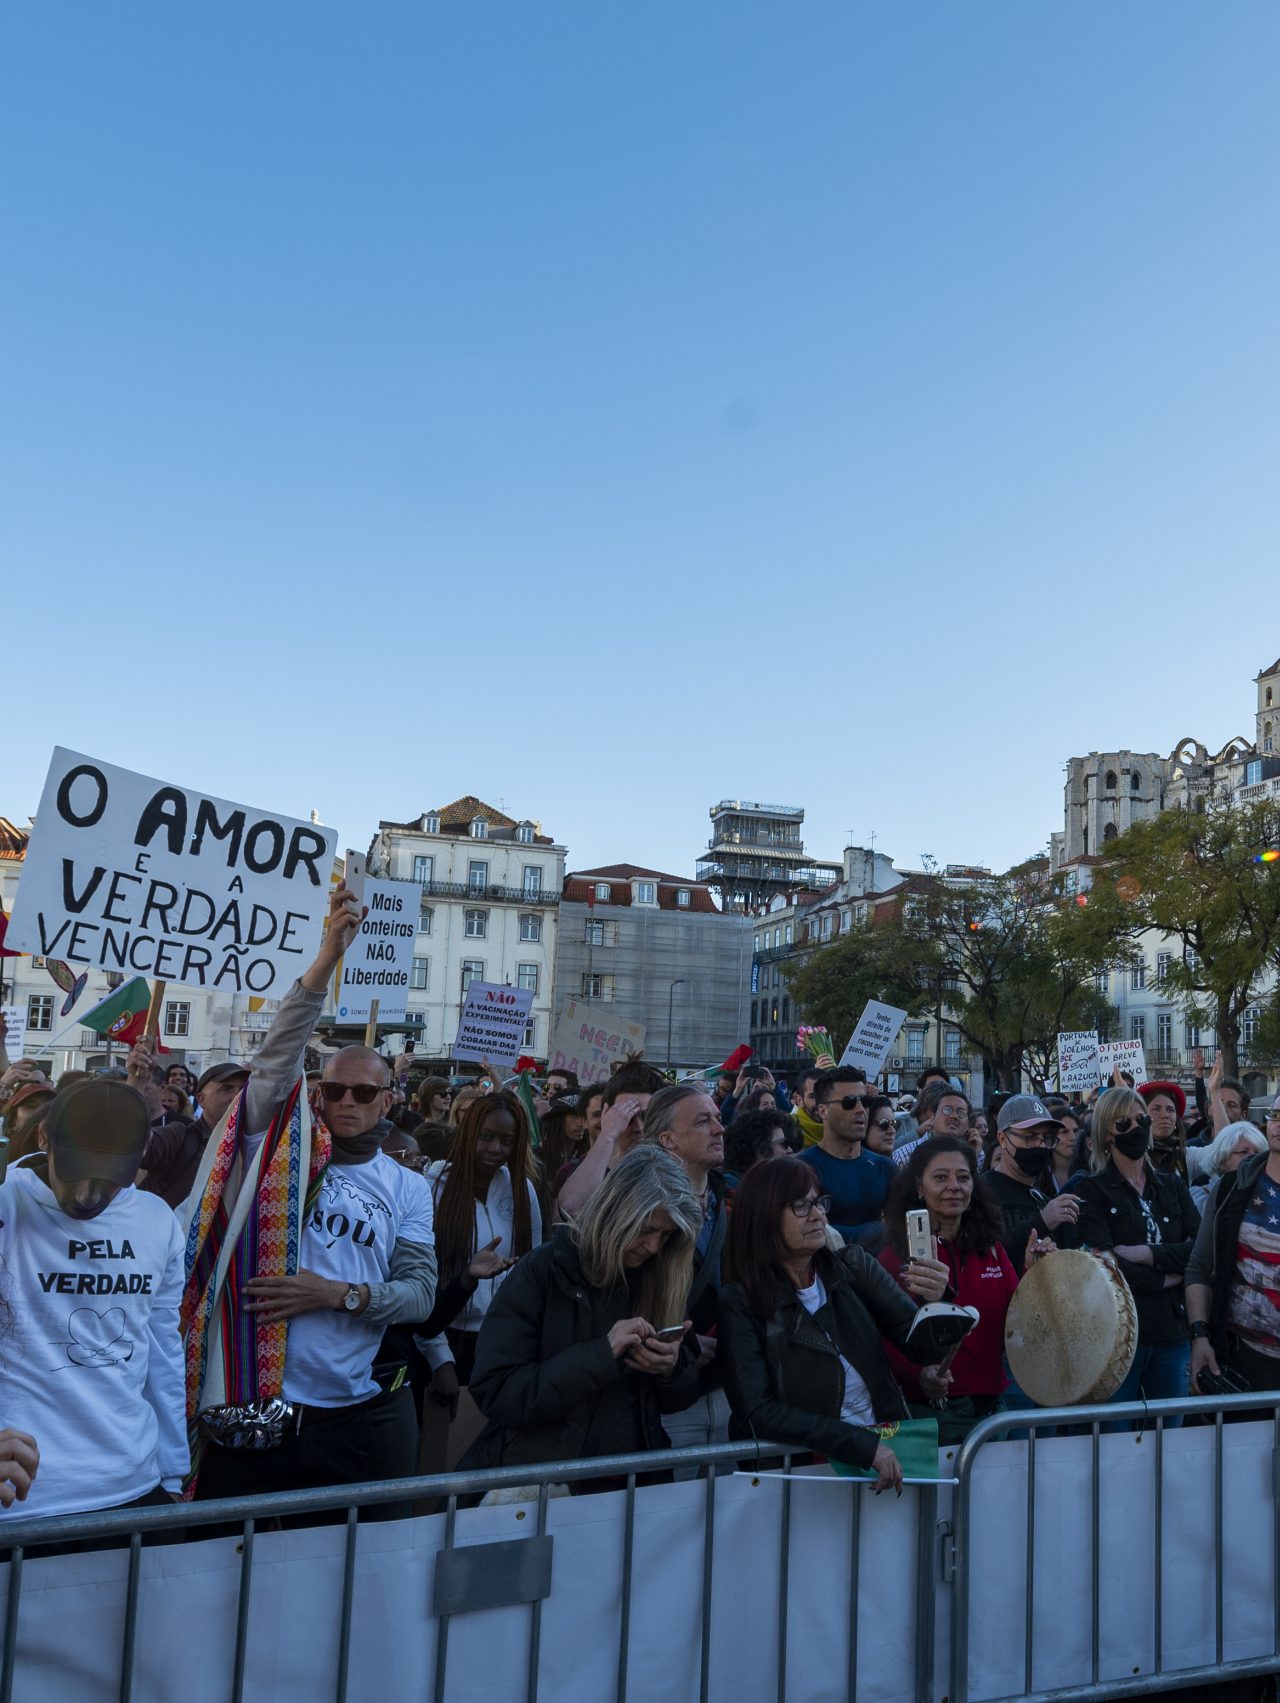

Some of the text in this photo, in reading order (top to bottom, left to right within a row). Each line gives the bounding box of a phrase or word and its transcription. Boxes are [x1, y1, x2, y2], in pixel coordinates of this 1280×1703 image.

[57, 764, 327, 886] O AMOR
[135, 853, 244, 894] E A
[62, 858, 310, 954] VERDADE
[371, 893, 403, 912] Mais
[362, 920, 414, 938] onteiras
[37, 912, 276, 992] VENCERÃO
[366, 940, 397, 963] NÃO,
[344, 968, 408, 986] Liberdade
[485, 991, 516, 1005] NÃO
[477, 1004, 526, 1018] VACINAÇÃO
[876, 1012, 891, 1023] Tenho
[866, 1020, 884, 1031] direito
[463, 1026, 518, 1041] NÃO SOMOS
[579, 1023, 634, 1055] NEED
[860, 1029, 883, 1040] escolher
[1060, 1030, 1097, 1043] PORTUGAL
[460, 1035, 516, 1050] COBAIAS DAS
[848, 1045, 864, 1055] quero
[857, 1038, 873, 1047] riscos
[1061, 1045, 1096, 1055] JOELHOS
[1107, 1040, 1140, 1052] FUTURO
[1100, 1055, 1109, 1063] EM
[1113, 1050, 1137, 1062] BREVE
[553, 1051, 610, 1082] DANC
[1067, 1071, 1098, 1083] BAZUCA
[68, 1239, 136, 1260] PELA
[37, 1272, 153, 1295] VERDADE
